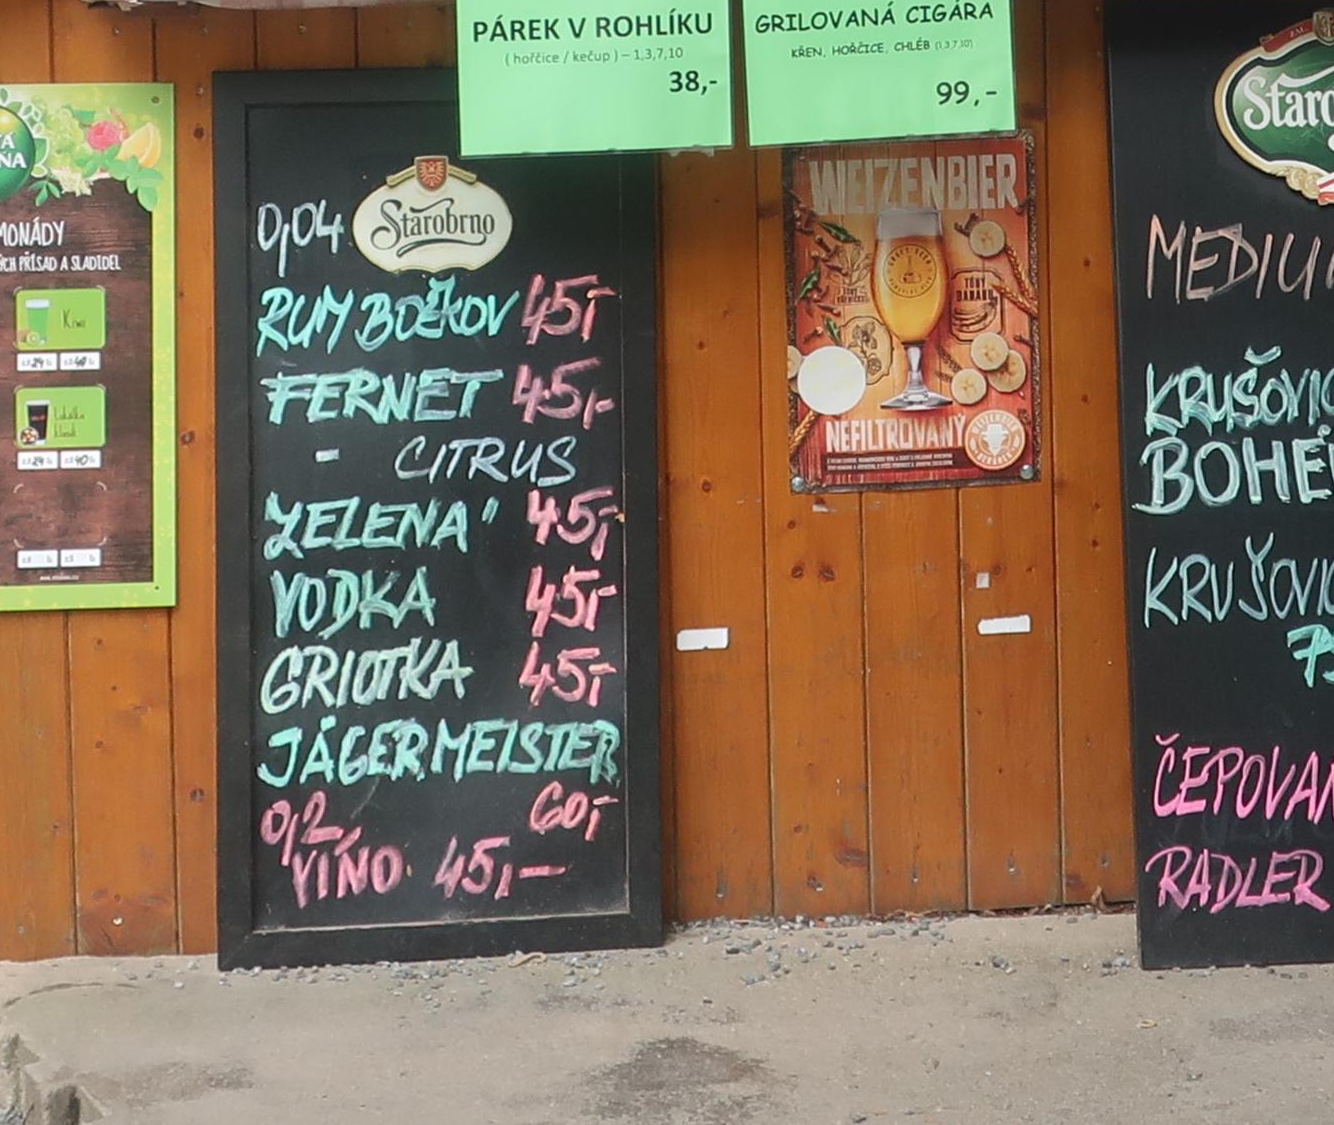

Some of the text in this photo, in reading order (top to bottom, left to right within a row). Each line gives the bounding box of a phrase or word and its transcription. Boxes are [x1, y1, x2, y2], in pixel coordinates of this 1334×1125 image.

[472, 7, 714, 44] PÁREK V ROHLÍKU
[754, 1, 895, 36] GRILOVANÁ
[893, 38, 931, 53] CHLÉB
[571, 47, 610, 66] kečup
[669, 70, 718, 96] 38,-
[935, 81, 998, 108] 99,-
[809, 153, 1021, 216] WEIZENBIER
[257, 201, 344, 278] 0,04
[369, 198, 497, 257] Starobrno
[60, 256, 68, 270] A
[71, 254, 122, 271] SLADIDEL
[257, 274, 615, 357] RUM BOŽKOV 45,-
[259, 355, 614, 429] FERNET 45,-
[395, 435, 577, 485] CITRUS
[825, 413, 964, 453] NEFILTROVANÝ
[527, 488, 620, 561] 45,-
[271, 565, 617, 639] VODKA 45,-
[260, 637, 617, 714] GRIOTKA 45,-
[529, 781, 619, 841] 60,-
[433, 836, 566, 900] 45,-
[1144, 841, 1330, 915] RADLER
